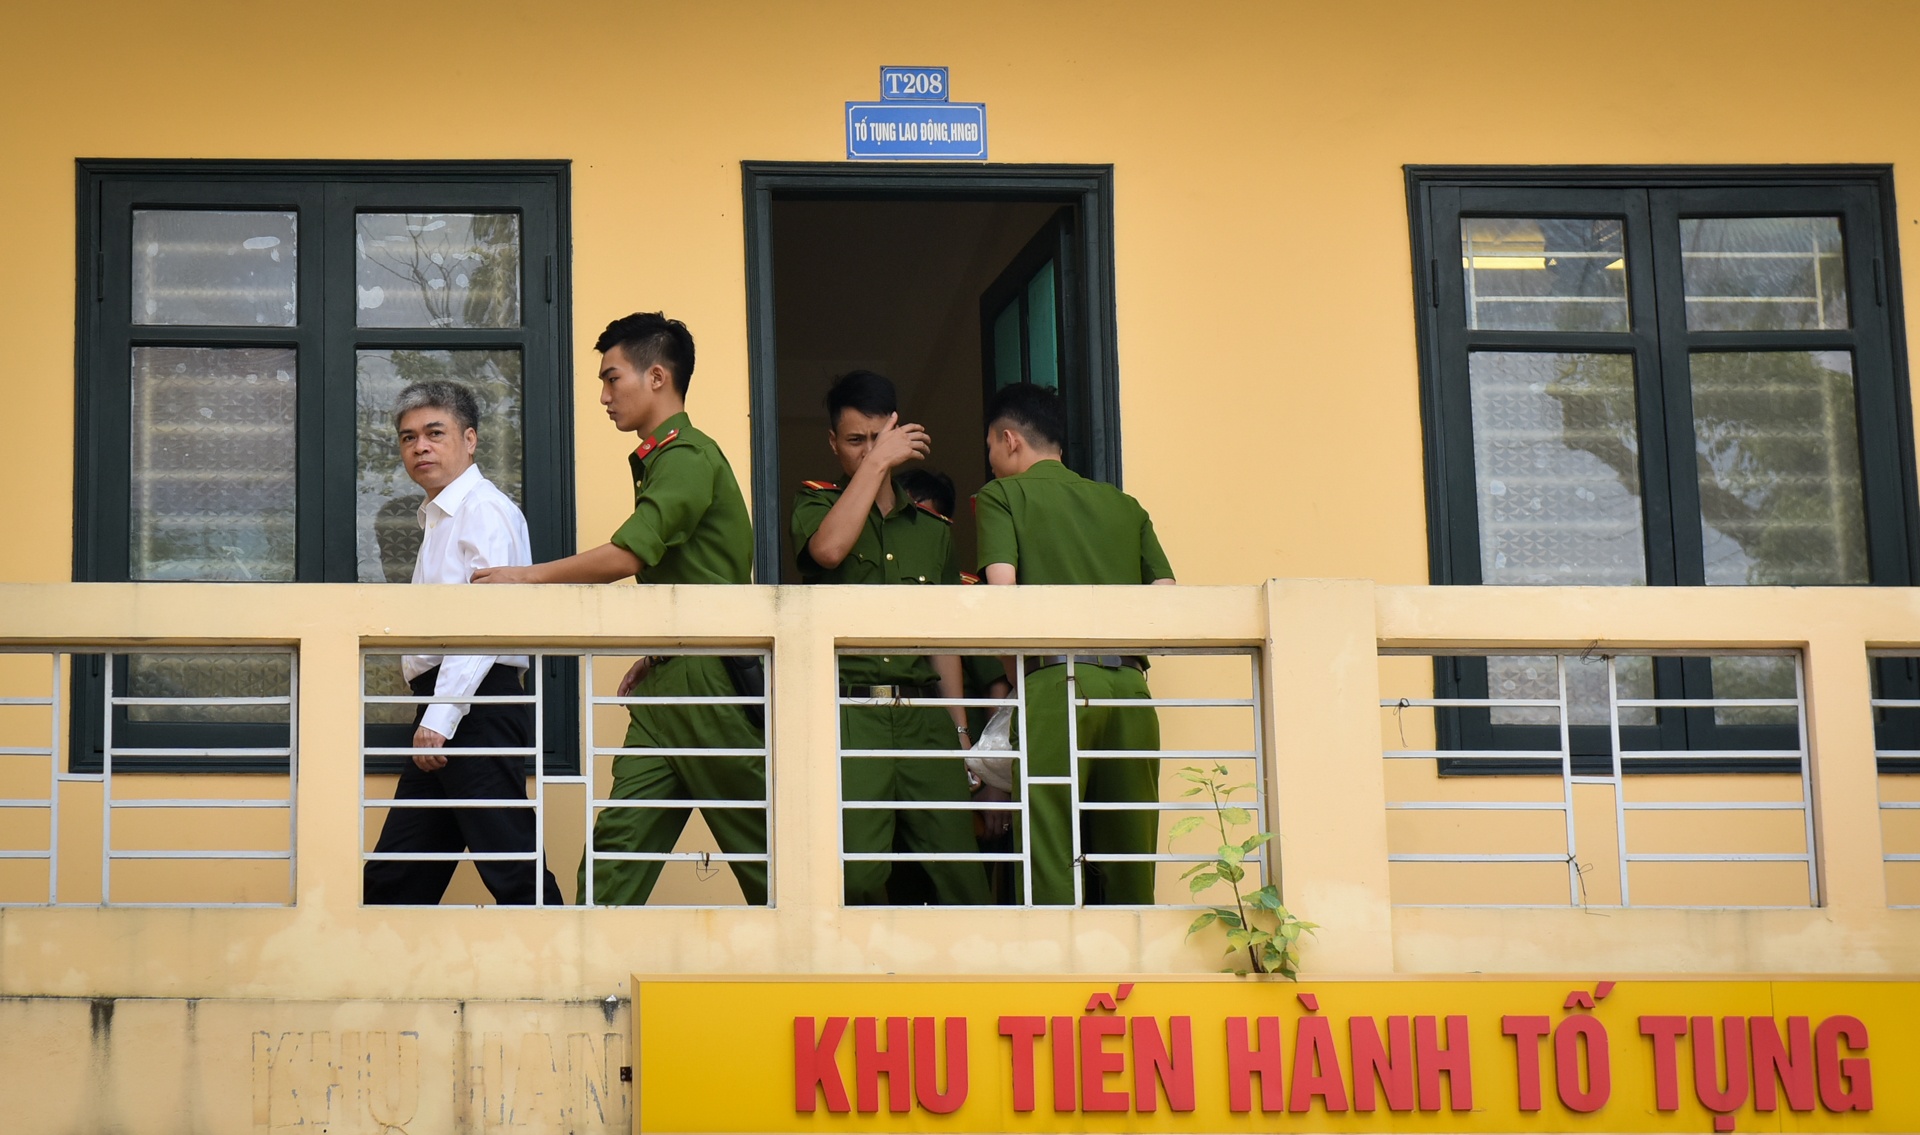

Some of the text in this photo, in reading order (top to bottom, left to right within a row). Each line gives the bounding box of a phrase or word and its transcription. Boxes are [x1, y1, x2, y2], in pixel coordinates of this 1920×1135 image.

[886, 73, 943, 94] T208
[855, 116, 868, 142] TỐ
[870, 122, 896, 145] TỤNG
[899, 122, 918, 142] LAO
[793, 981, 1874, 1133] KHU TIẾN HÀNH TỐ TỤNG
